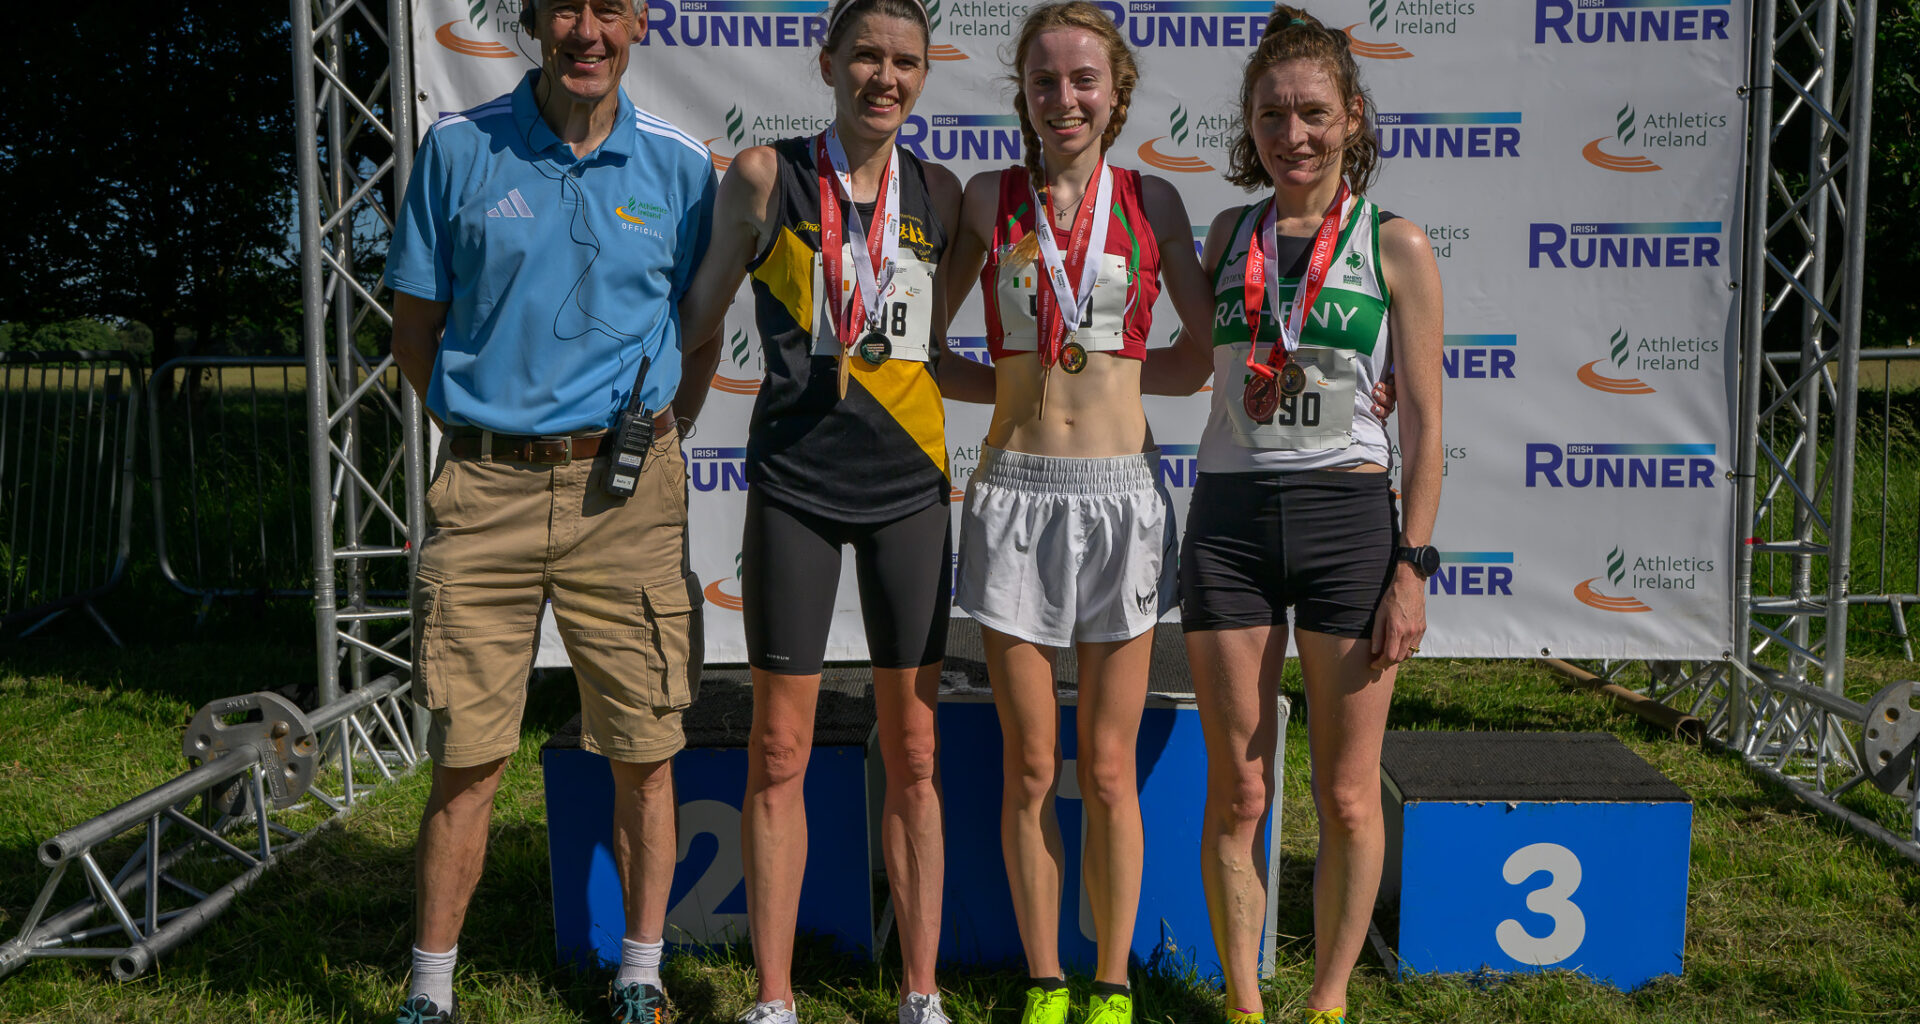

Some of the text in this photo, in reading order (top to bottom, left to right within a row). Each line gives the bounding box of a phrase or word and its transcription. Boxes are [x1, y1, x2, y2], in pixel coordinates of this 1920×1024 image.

[681, 2, 706, 10] IRISH
[949, 2, 1028, 19] Athletics
[1131, 3, 1155, 11] IRISH
[1395, 0, 1475, 16] Athletics
[1579, 0, 1604, 8] IRISH
[640, 0, 829, 47] RUNNER
[949, 20, 1010, 36] Ireland
[1395, 19, 1456, 35] Ireland
[1534, 0, 1730, 44] RUNNER
[752, 114, 831, 131] Athletics
[933, 116, 958, 125] IRISH
[1643, 112, 1726, 129] Athletics
[895, 114, 1020, 160] RUNN
[1196, 132, 1233, 148] Irela
[1376, 127, 1520, 158] UNNER
[1643, 130, 1707, 148] Ireland
[621, 222, 664, 239] OFFICIAL
[1425, 224, 1470, 240] letics
[1573, 225, 1598, 233] IRISH
[1309, 218, 1335, 282] IRISH RUNNER
[1529, 223, 1721, 268] RUNNER
[1252, 260, 1263, 284] IRISH
[1637, 337, 1719, 353] Athletics
[1443, 349, 1516, 379] NER
[1637, 354, 1700, 371] Ireland
[1257, 391, 1321, 427] 90
[693, 449, 718, 458] IRISH
[1568, 445, 1593, 454] IRISH
[1525, 443, 1715, 488] RUNNER
[1632, 556, 1715, 573] Athletics
[1429, 566, 1513, 596] NER
[1632, 573, 1696, 590] Ireland
[1495, 842, 1586, 966] 3
